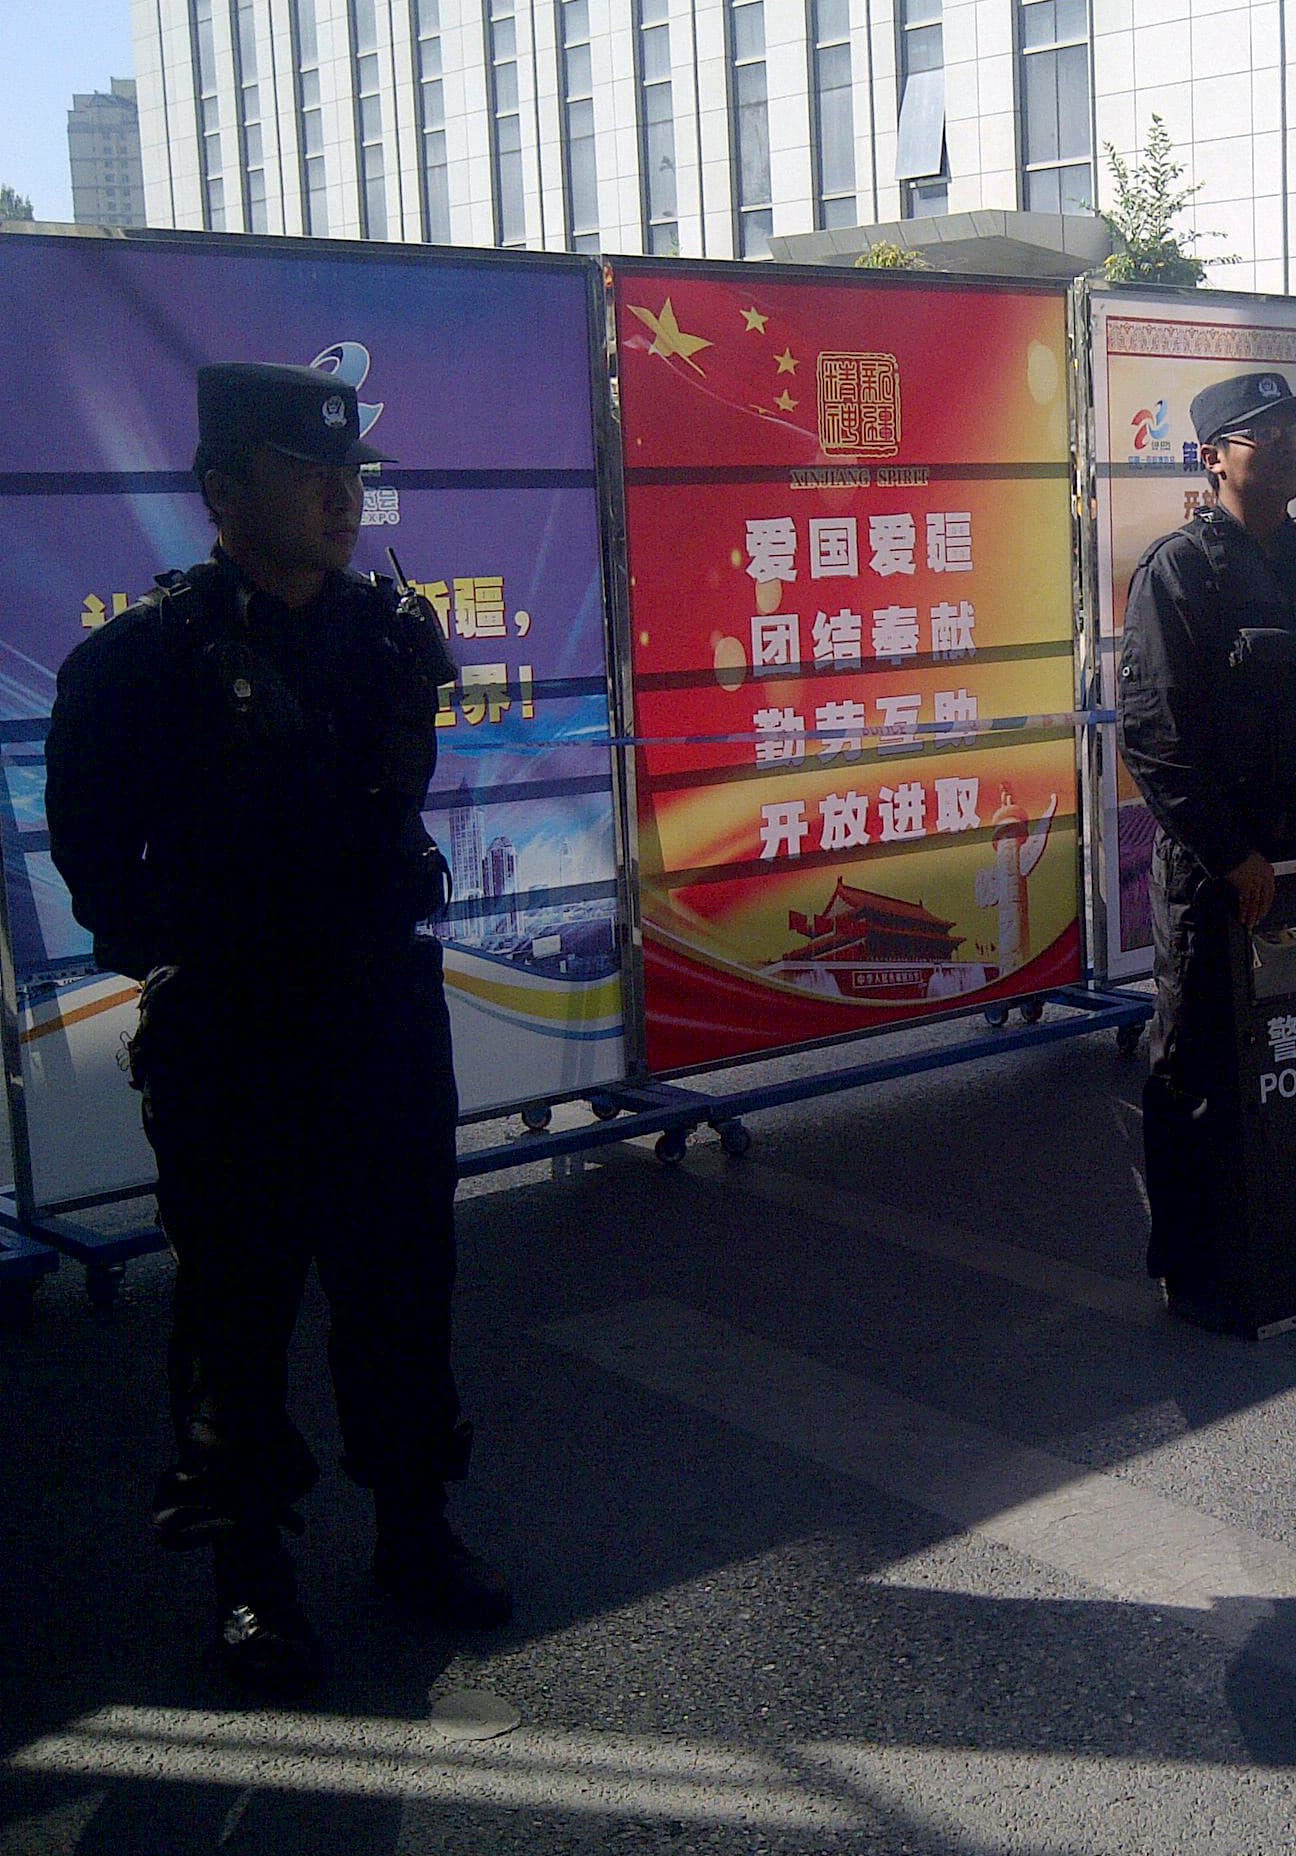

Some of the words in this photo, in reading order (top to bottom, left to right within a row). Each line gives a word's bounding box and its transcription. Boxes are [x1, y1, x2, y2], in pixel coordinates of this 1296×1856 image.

[791, 467, 870, 489] XINJIANG
[876, 466, 929, 487] SPIRIT
[745, 512, 974, 584] 爱国爱疆
[751, 600, 976, 678] 团结奉献
[753, 688, 979, 769] 勤劳互助
[760, 777, 981, 861] 开放进取
